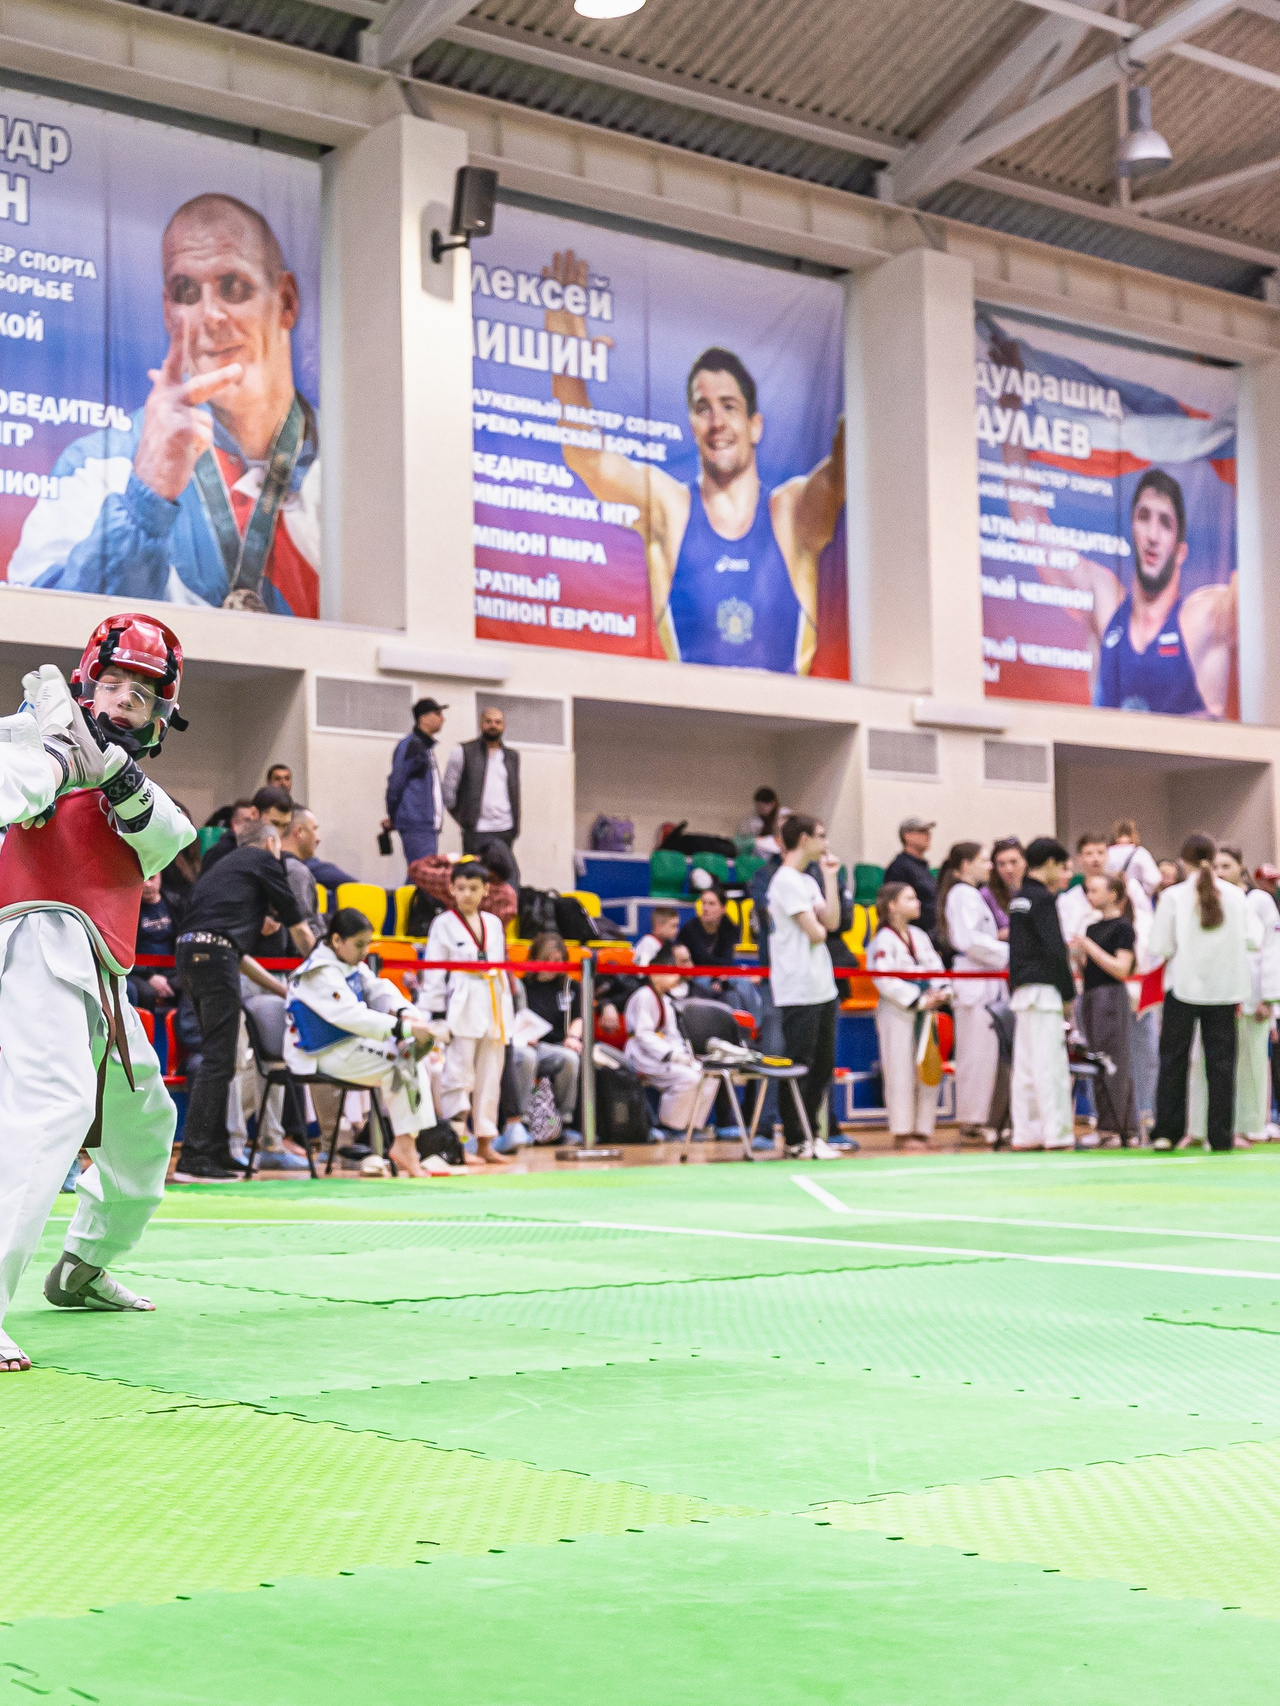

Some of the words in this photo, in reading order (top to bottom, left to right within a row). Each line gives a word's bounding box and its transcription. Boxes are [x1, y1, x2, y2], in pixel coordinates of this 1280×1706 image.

[19, 249, 97, 280] СПОРТА
[472, 264, 612, 321] лексей
[473, 319, 608, 382] ИШИН
[976, 362, 1124, 420] дулрашид
[977, 403, 1091, 460] ДУЛАЕВ
[473, 451, 574, 489] БЕДИТЕЛЬ
[474, 524, 548, 557] МПИОН
[475, 595, 547, 626] МПИОН
[549, 604, 637, 638] ЕВРОПЫ
